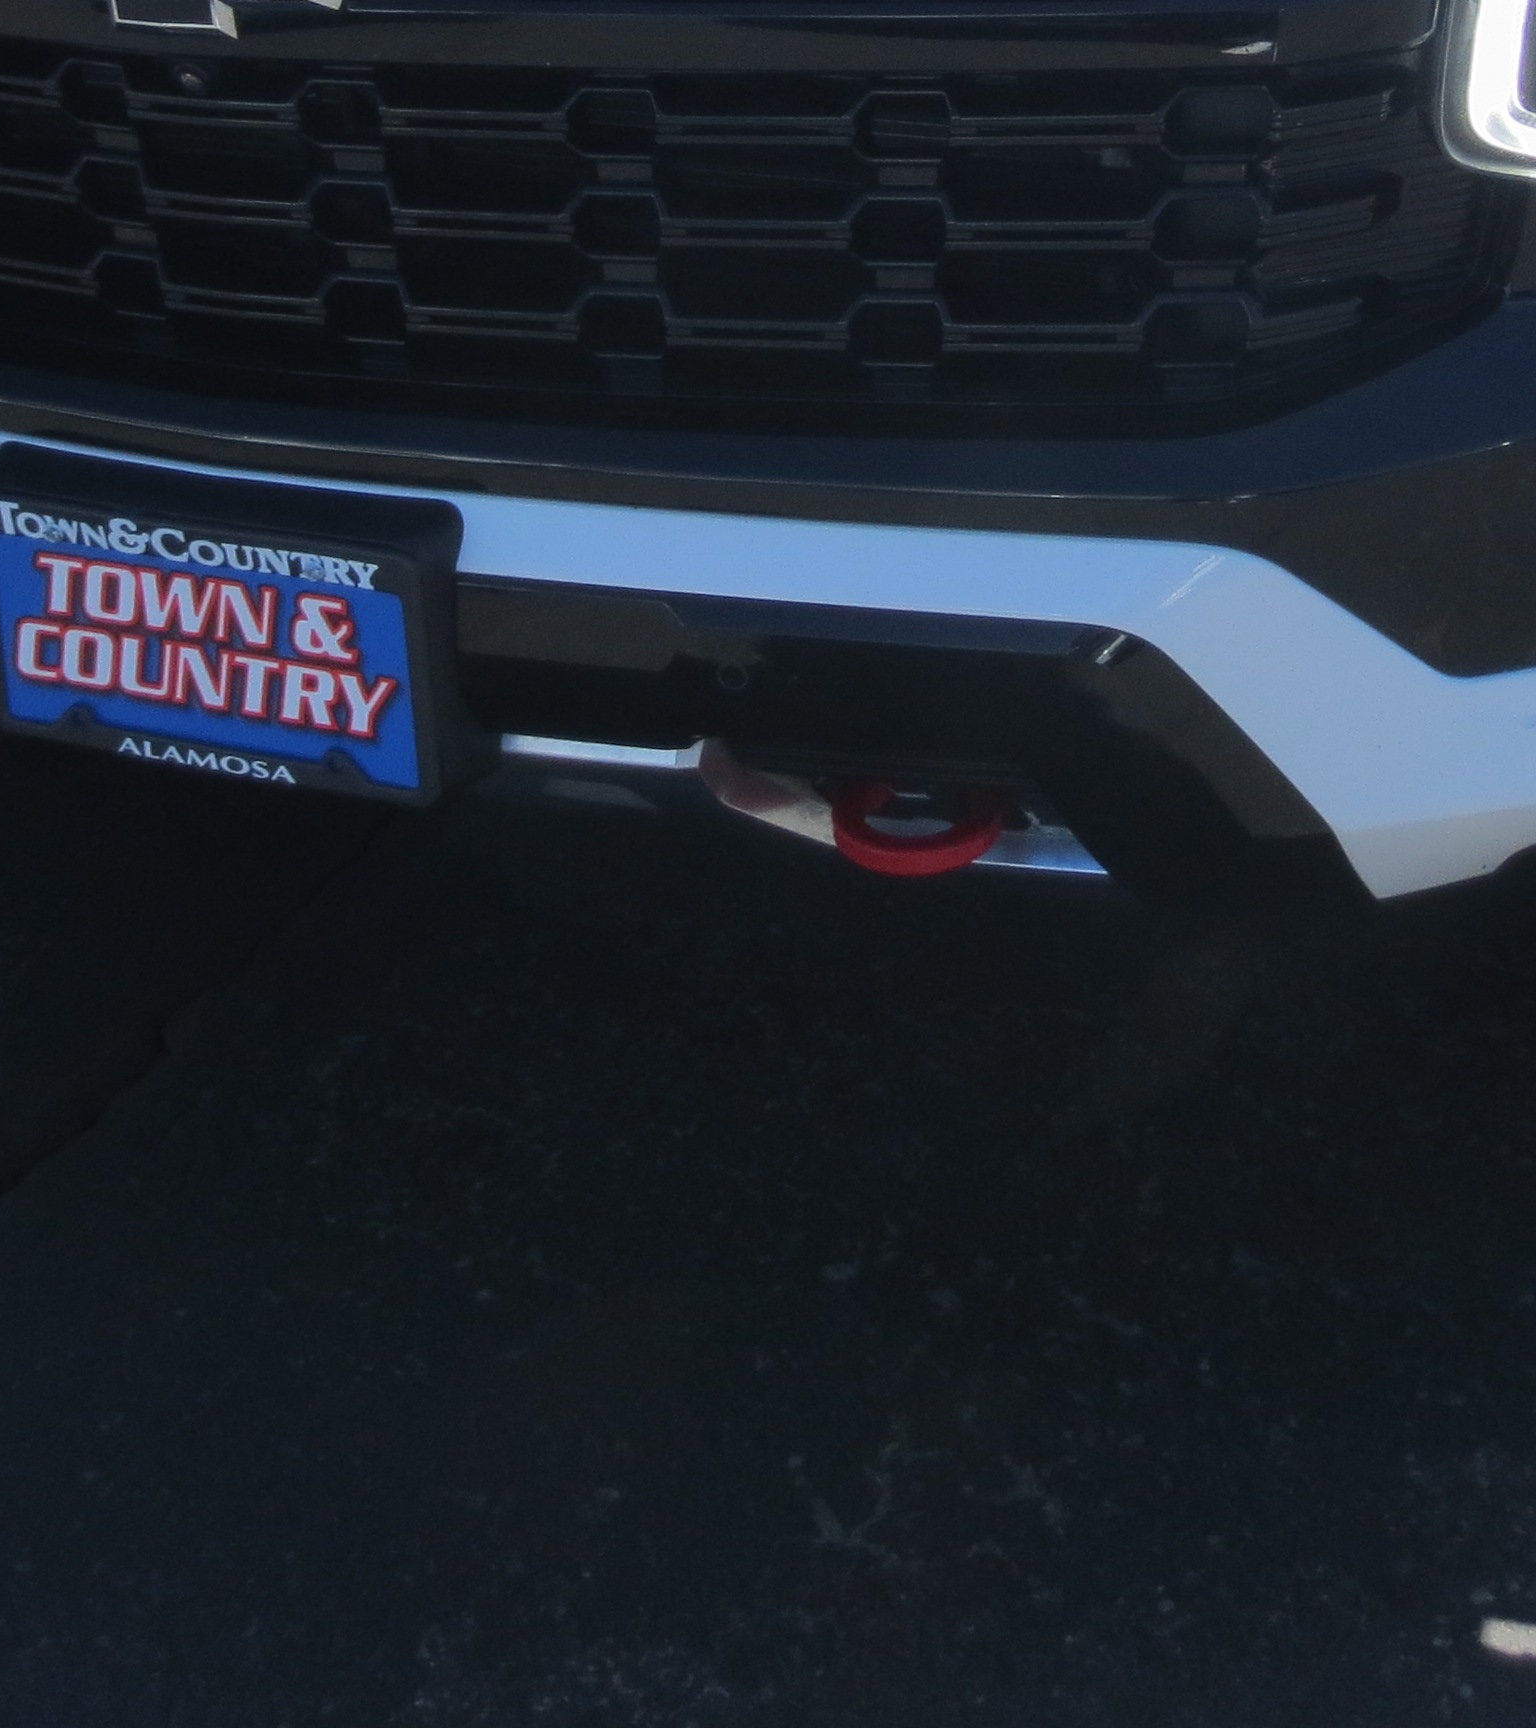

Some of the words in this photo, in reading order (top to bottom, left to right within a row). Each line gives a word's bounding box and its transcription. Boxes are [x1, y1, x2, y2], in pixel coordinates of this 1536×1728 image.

[36, 553, 277, 649] TOWN
[292, 593, 359, 663] &
[16, 618, 396, 738] COUNTRY
[117, 737, 297, 784] ALAMOSA
